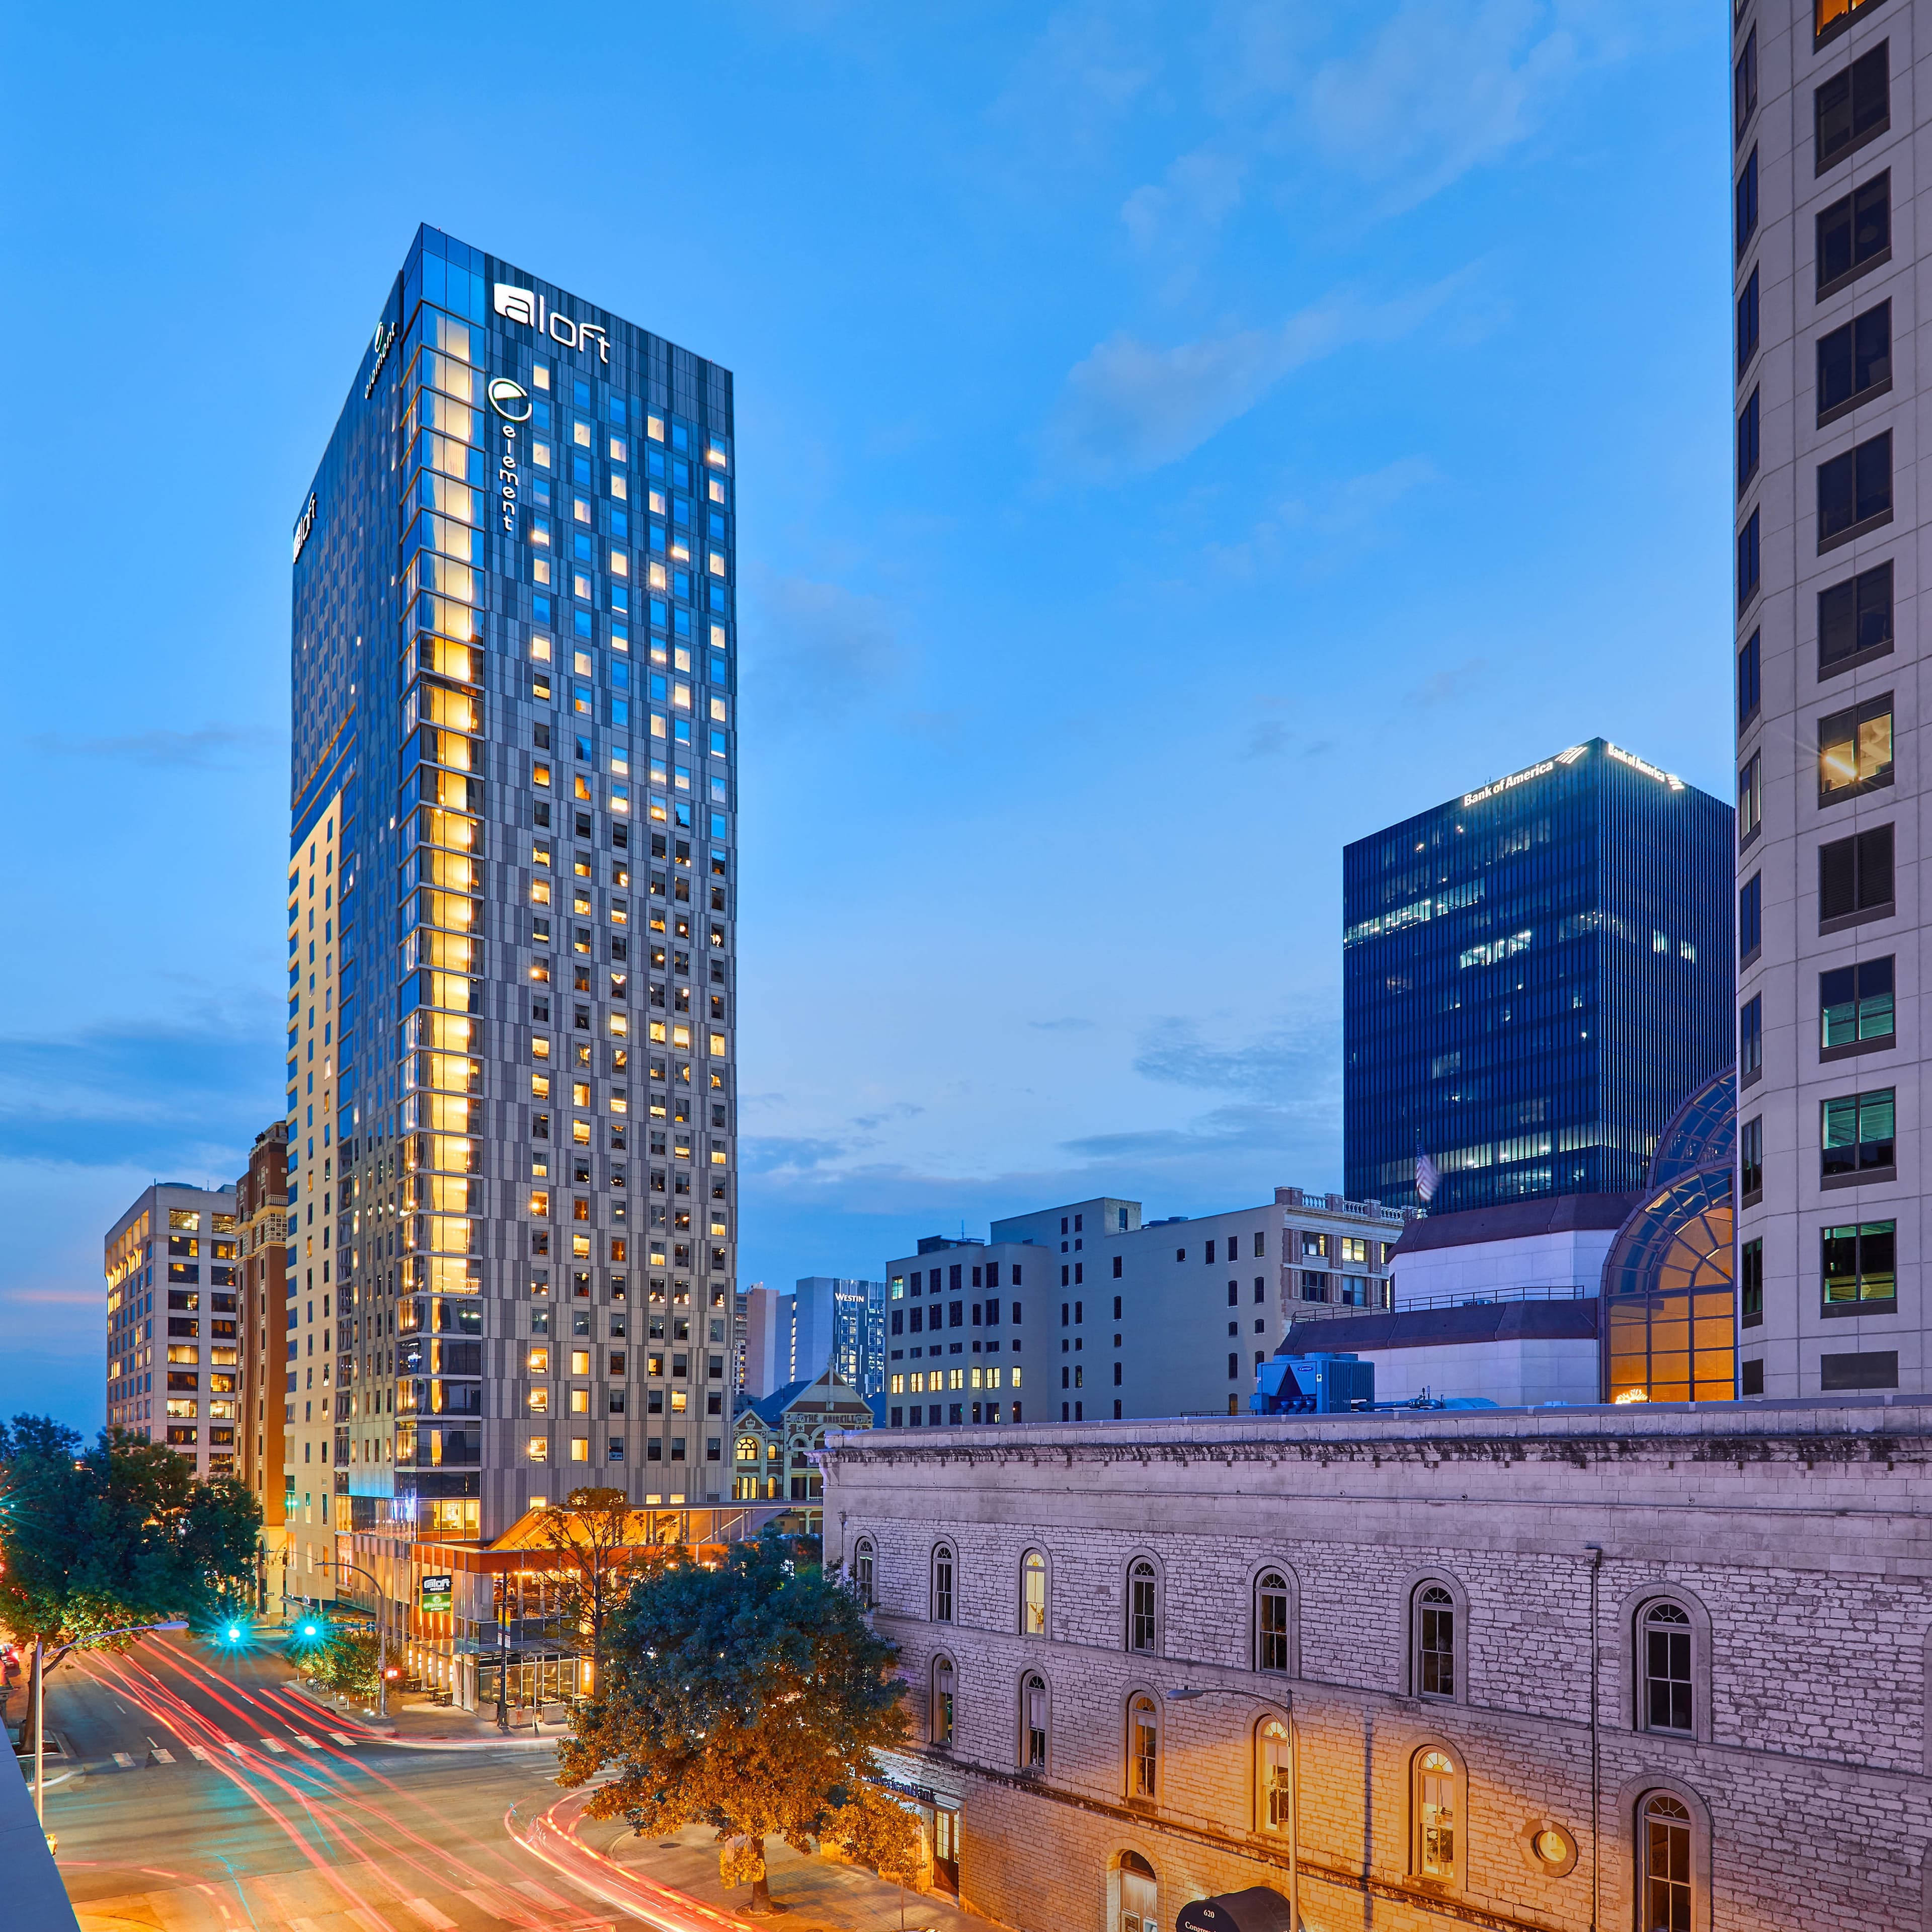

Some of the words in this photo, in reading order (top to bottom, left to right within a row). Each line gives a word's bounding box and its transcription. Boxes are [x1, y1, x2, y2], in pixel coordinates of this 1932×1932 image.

[494, 283, 610, 363] aloft
[499, 425, 518, 531] element
[1608, 743, 1628, 763] Bank
[1627, 755, 1636, 767] of
[1636, 756, 1665, 782] America
[1464, 786, 1492, 807] Bank
[1493, 779, 1505, 793] of
[1505, 761, 1553, 789] America
[805, 1414, 818, 1423] THE
[823, 1415, 855, 1423] DRISKILL
[1203, 1909, 1215, 1918] 620
